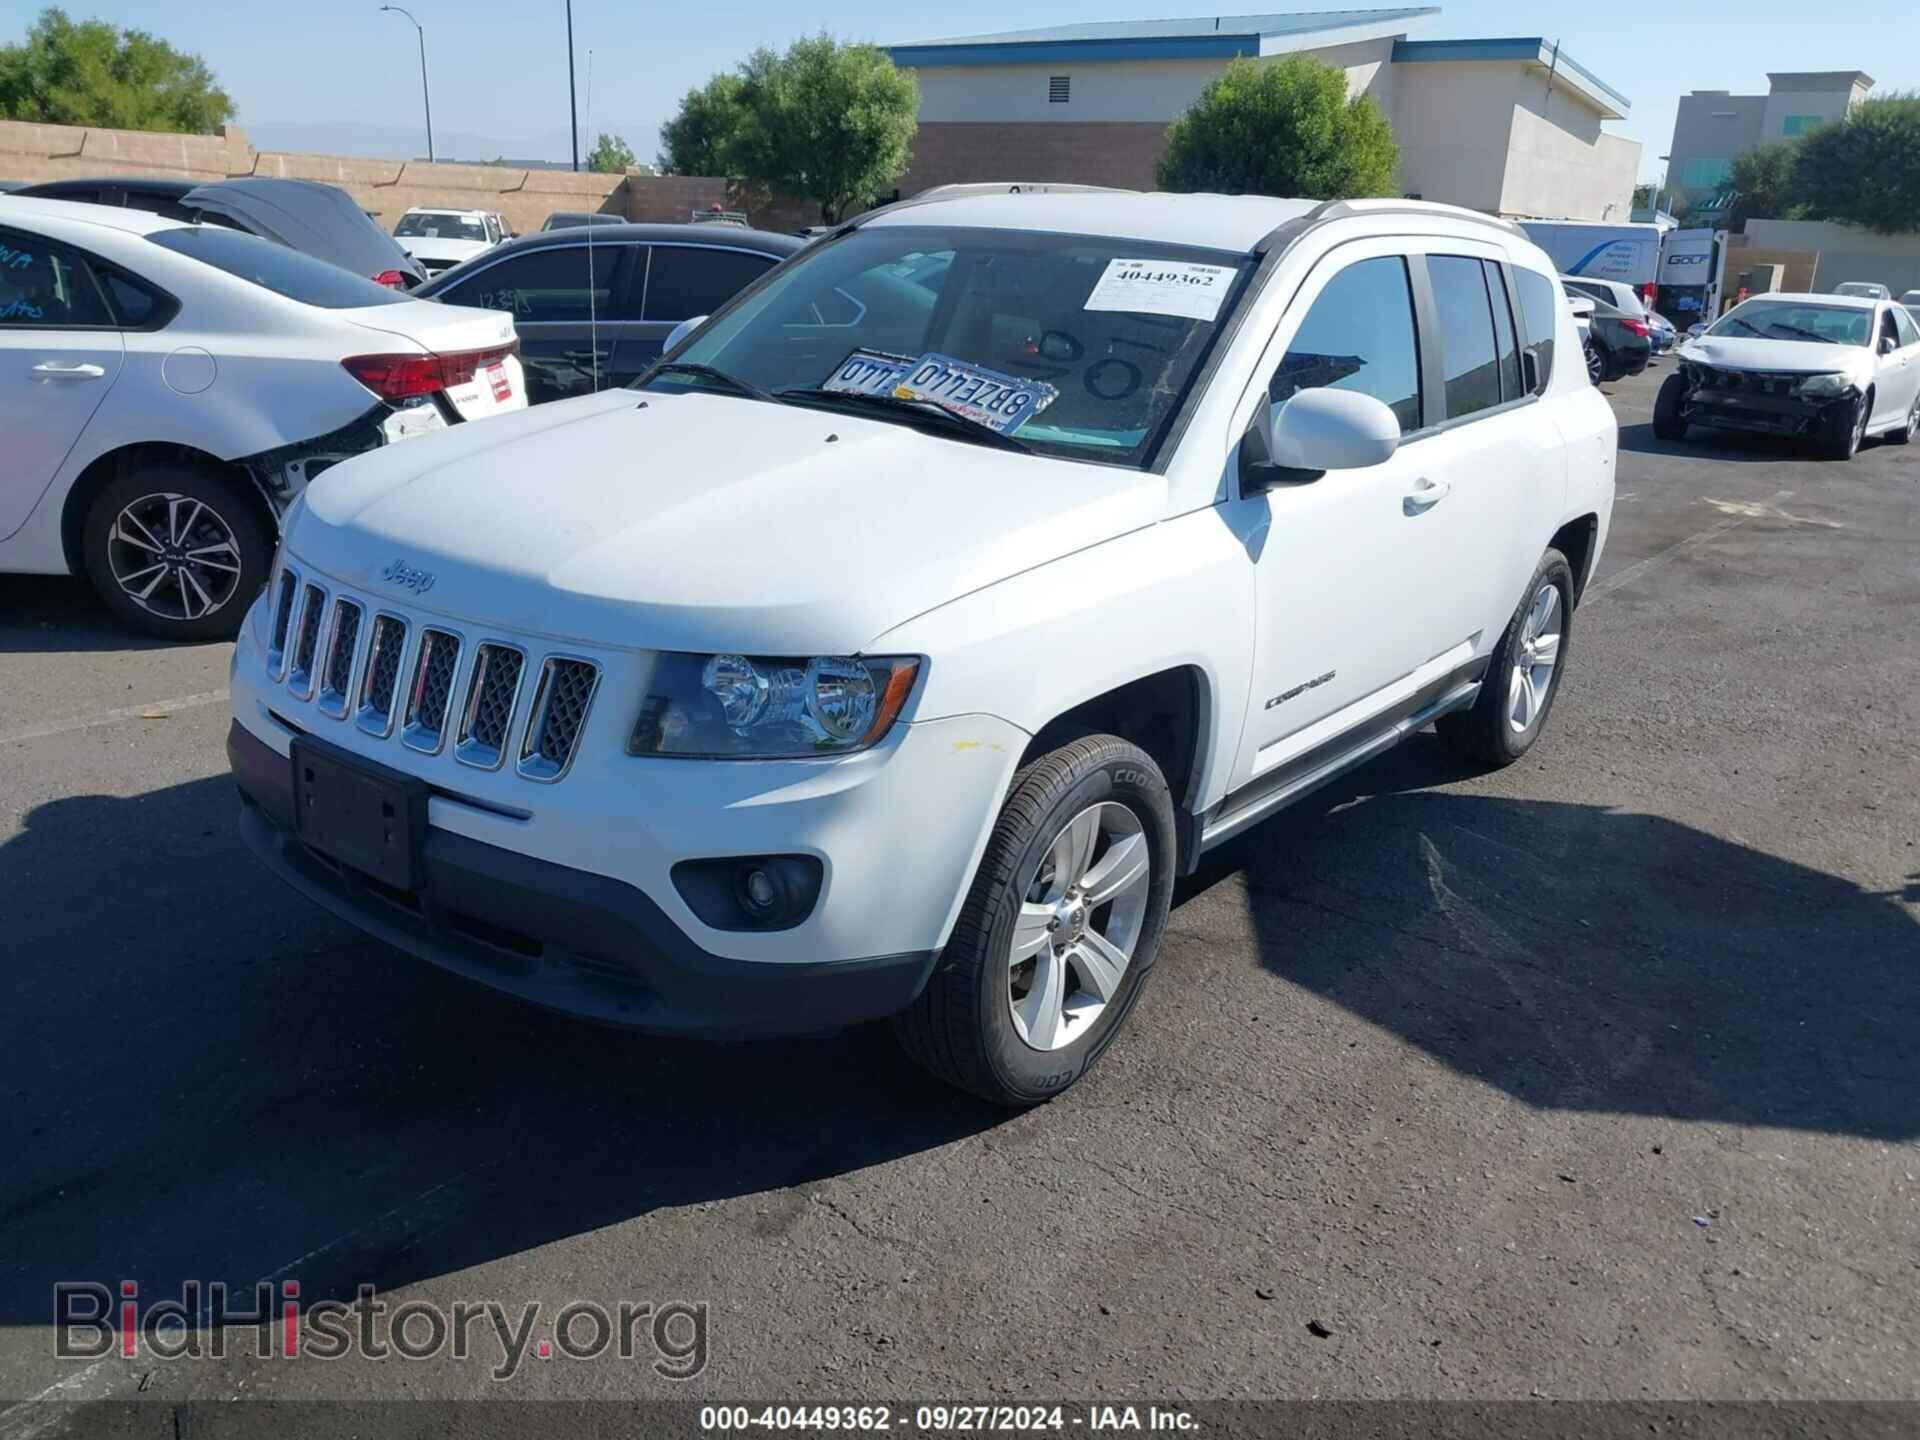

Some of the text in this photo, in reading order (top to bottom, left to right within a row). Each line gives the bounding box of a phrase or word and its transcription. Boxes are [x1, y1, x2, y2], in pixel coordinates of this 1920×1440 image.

[1668, 254, 1710, 265] GOLF
[1116, 270, 1214, 287] 40449362
[841, 361, 893, 388] 440
[912, 364, 1031, 416] 8BZE440
[383, 559, 436, 596] Jeep
